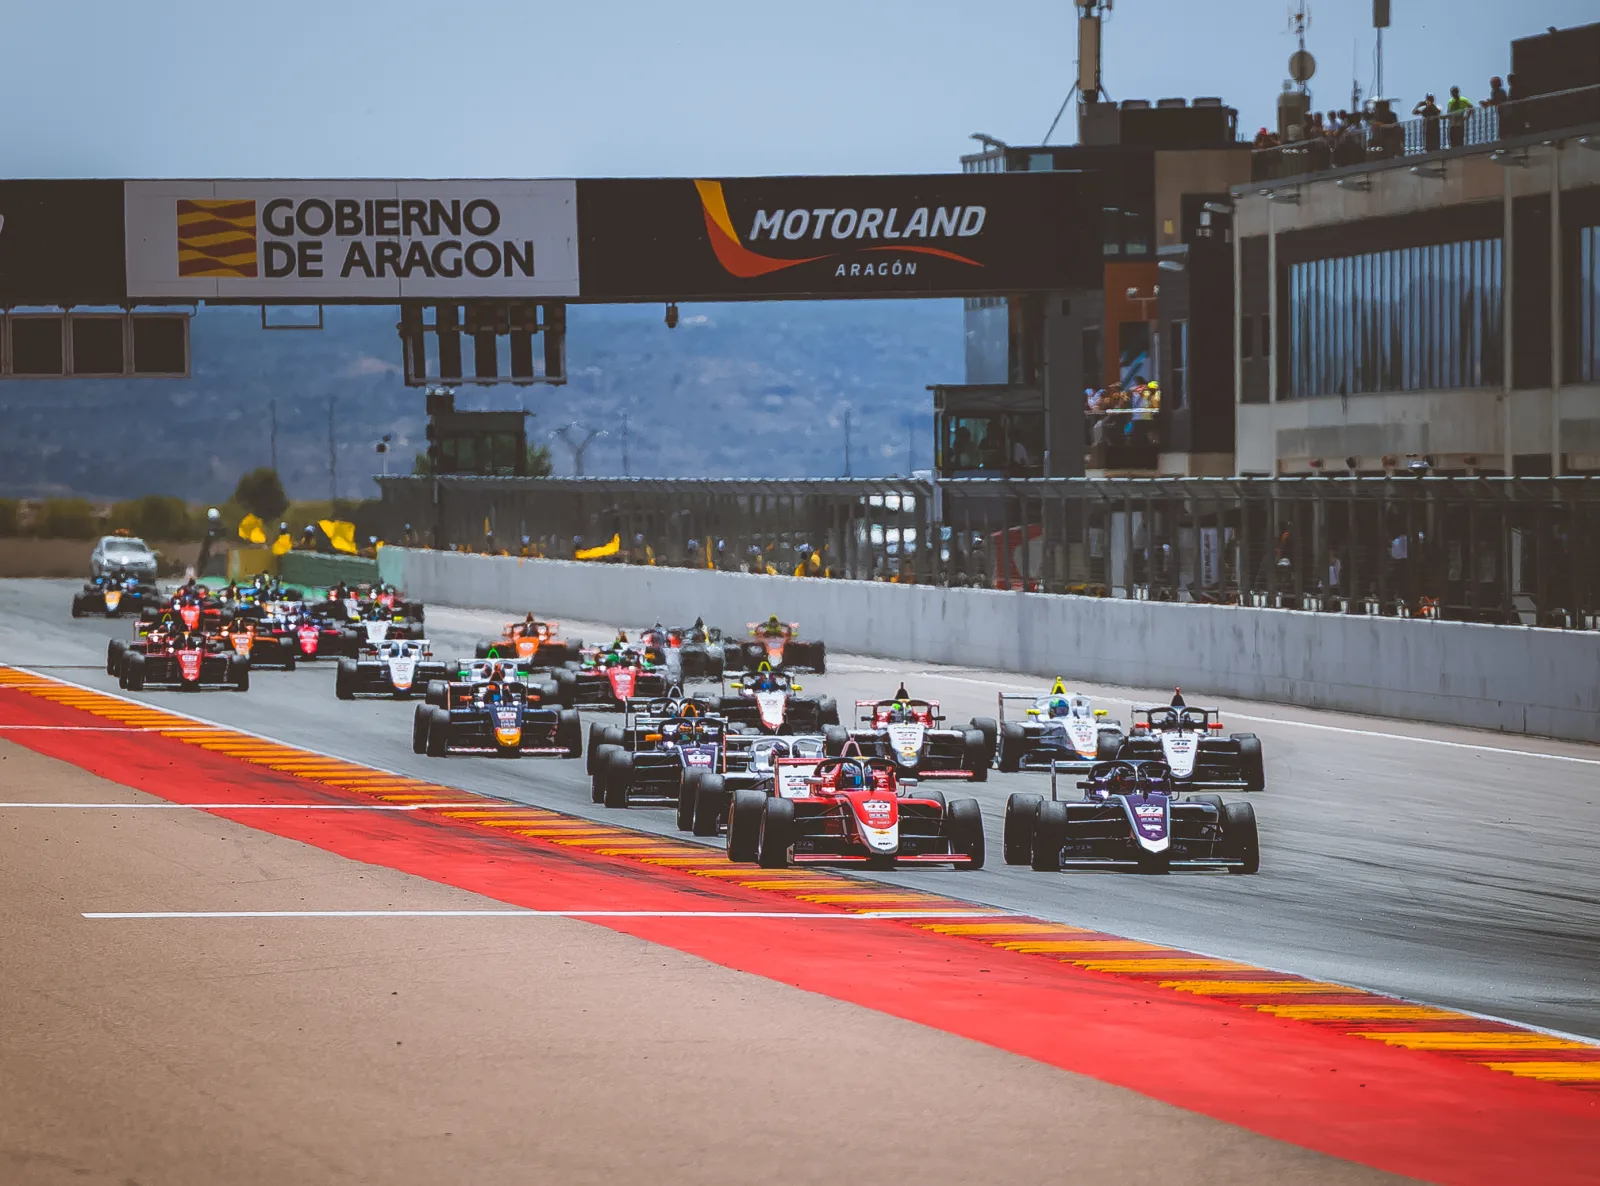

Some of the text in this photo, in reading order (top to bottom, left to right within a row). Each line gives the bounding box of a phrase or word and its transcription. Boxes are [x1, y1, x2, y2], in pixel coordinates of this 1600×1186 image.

[262, 199, 501, 237] GOBIERNO
[749, 205, 987, 241] MOTORLAND
[263, 240, 535, 278] DE ARAGON
[835, 259, 917, 277] ARAGÓN
